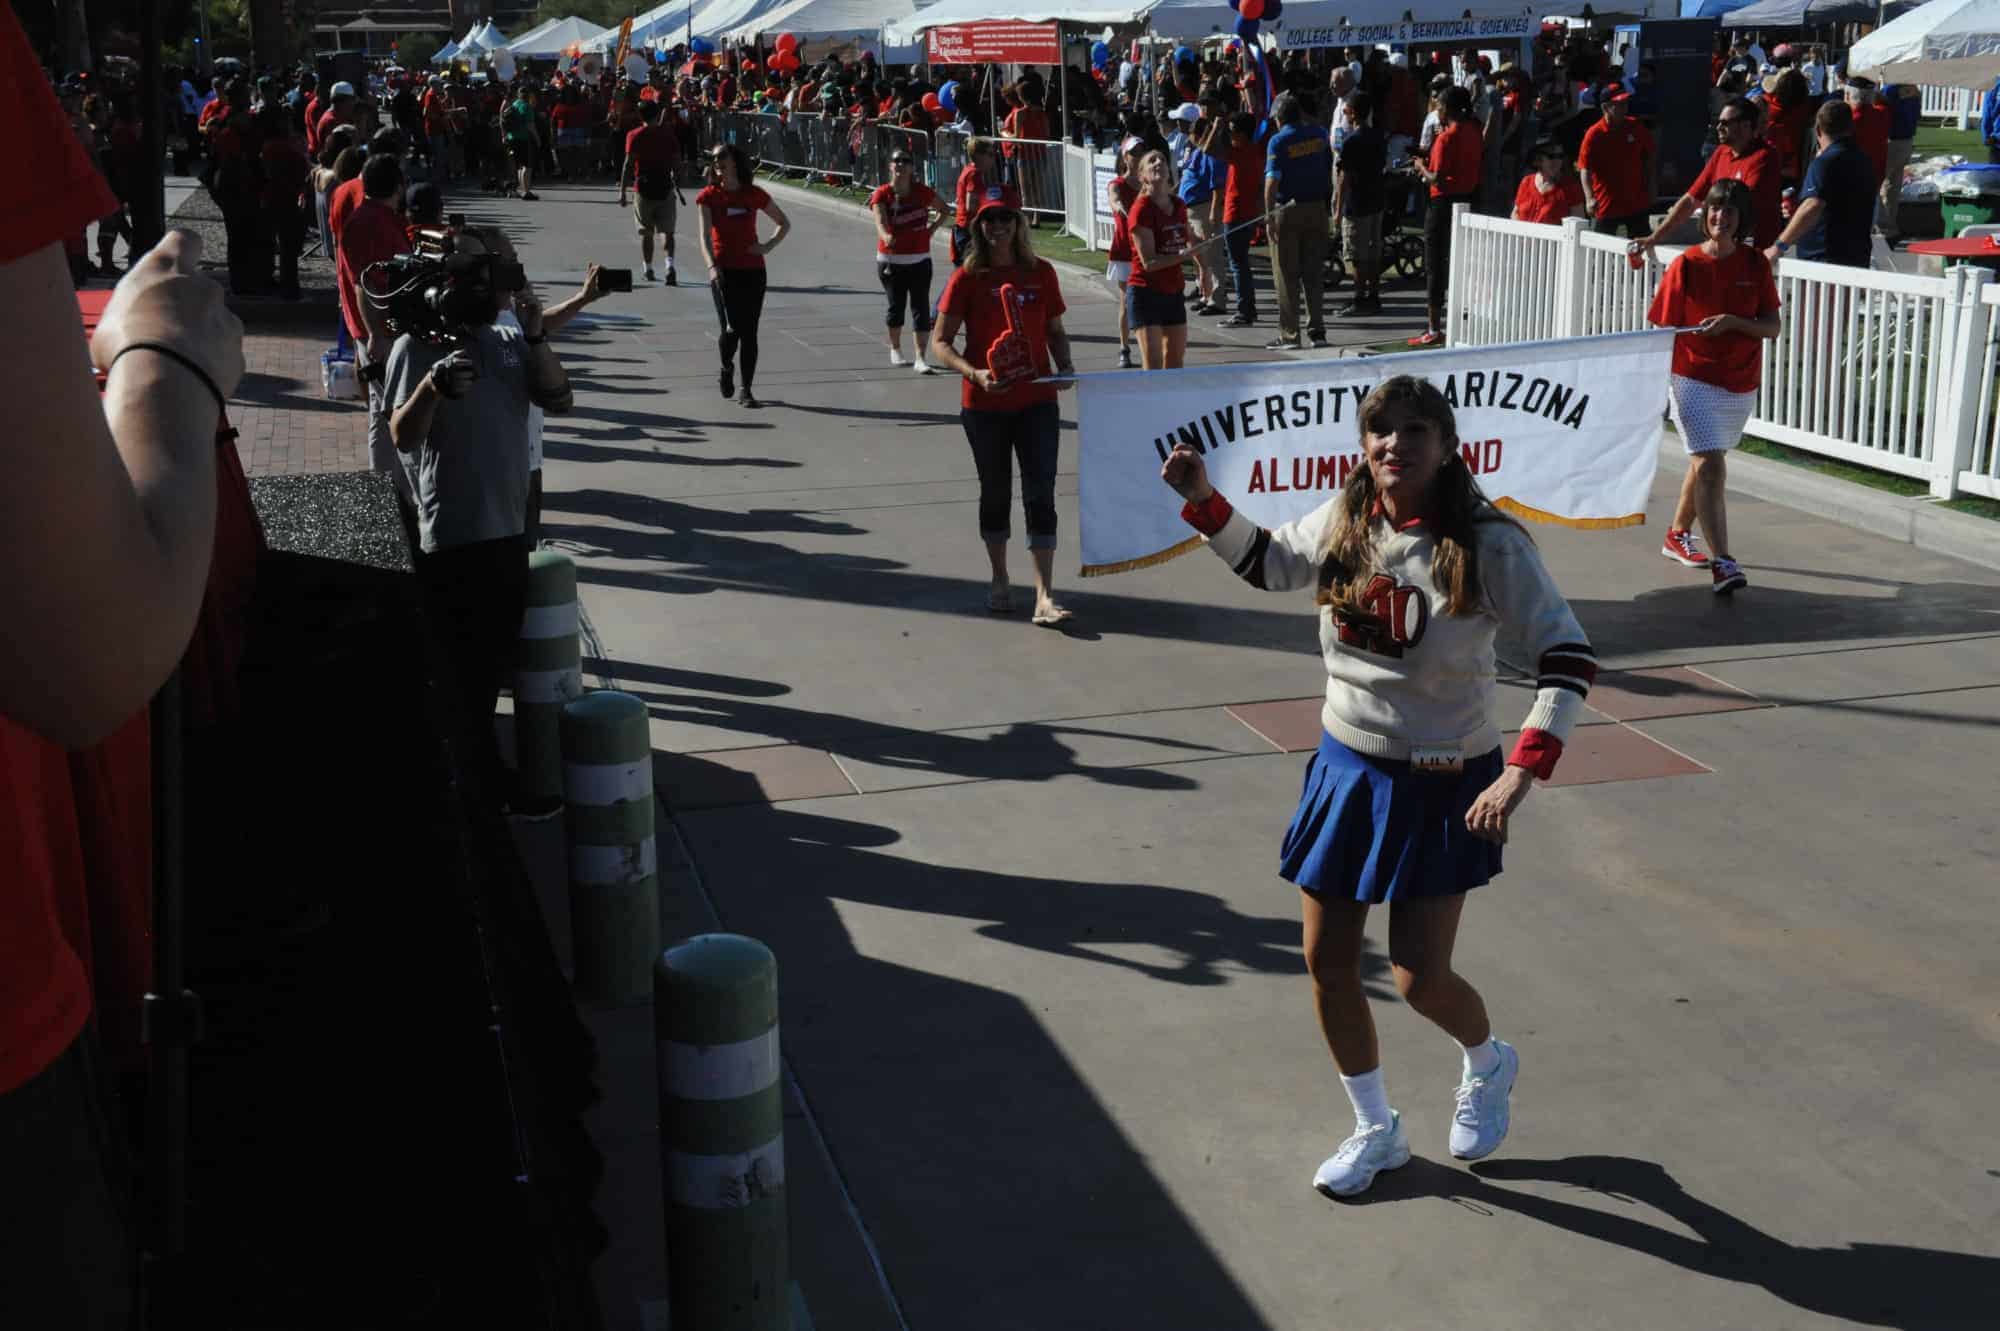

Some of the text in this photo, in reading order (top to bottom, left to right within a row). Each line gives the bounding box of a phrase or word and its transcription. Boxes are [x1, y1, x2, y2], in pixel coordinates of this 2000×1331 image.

[1287, 18, 1529, 46] COLLEGE OF SOCIAL & BEHAVIORAL SCIENCES
[1444, 371, 1590, 430] ARIZONA
[1248, 454, 1366, 494] ALUMN
